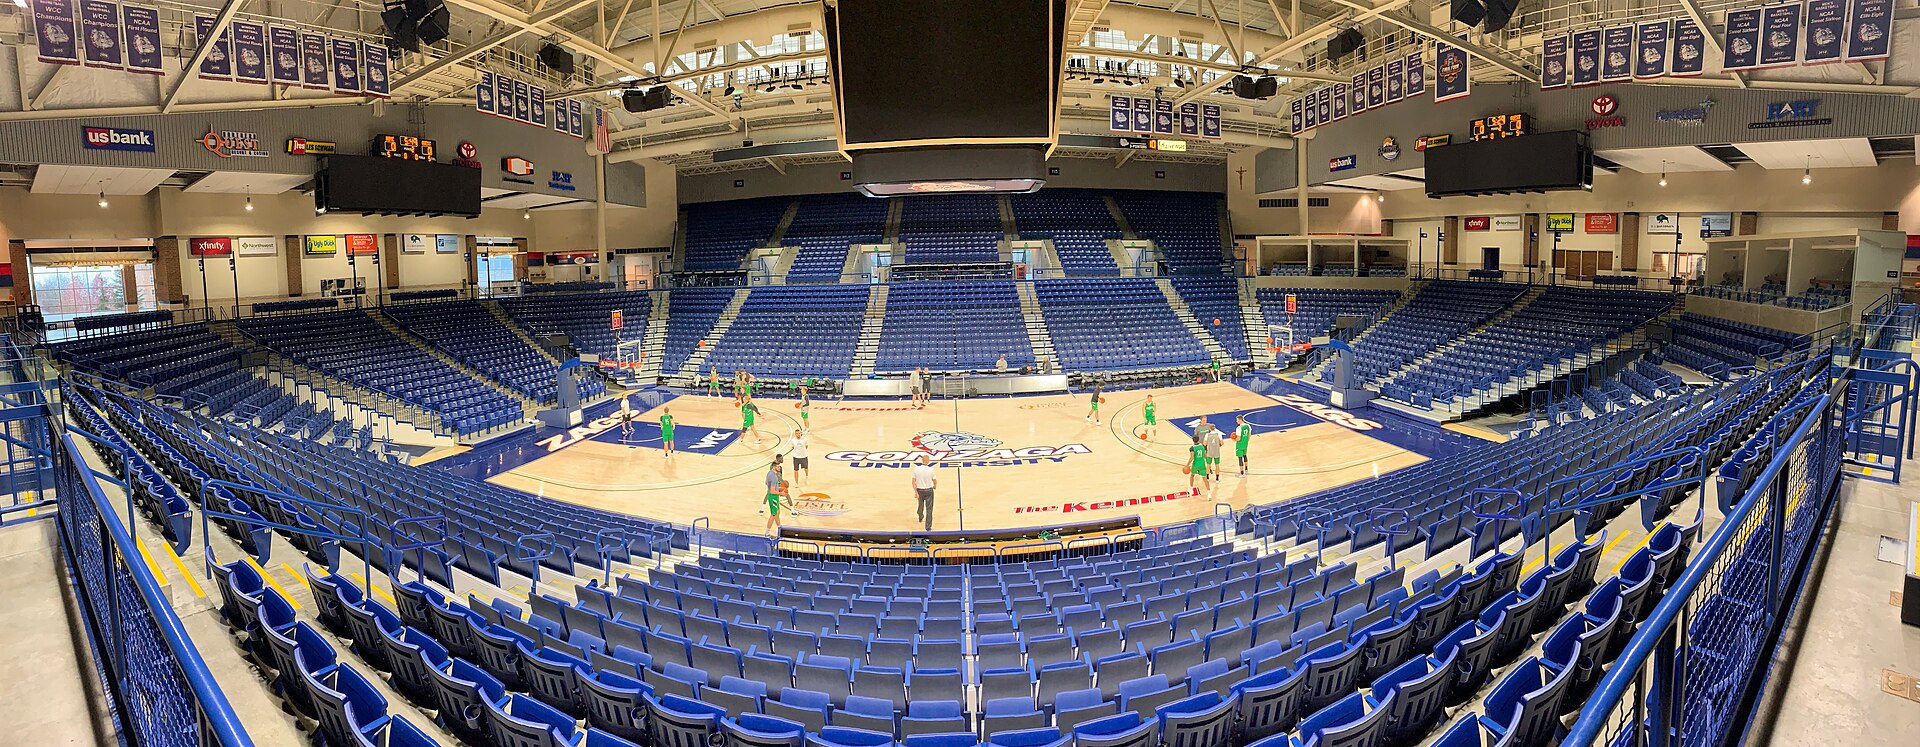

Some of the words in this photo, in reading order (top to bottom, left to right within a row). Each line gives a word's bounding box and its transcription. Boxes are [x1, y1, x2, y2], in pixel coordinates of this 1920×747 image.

[36, 12, 72, 23] Champions
[84, 19, 118, 28] Champions
[1585, 118, 1624, 129] TOYOTA
[88, 130, 150, 146] usbank
[200, 127, 258, 157] QUEST
[1330, 157, 1352, 168] usbank
[199, 242, 224, 251] xfinity
[1266, 394, 1384, 431] ZAGS
[824, 443, 1093, 461] GONZAGA
[1014, 505, 1058, 513] The
[1062, 487, 1201, 513] Kennel
